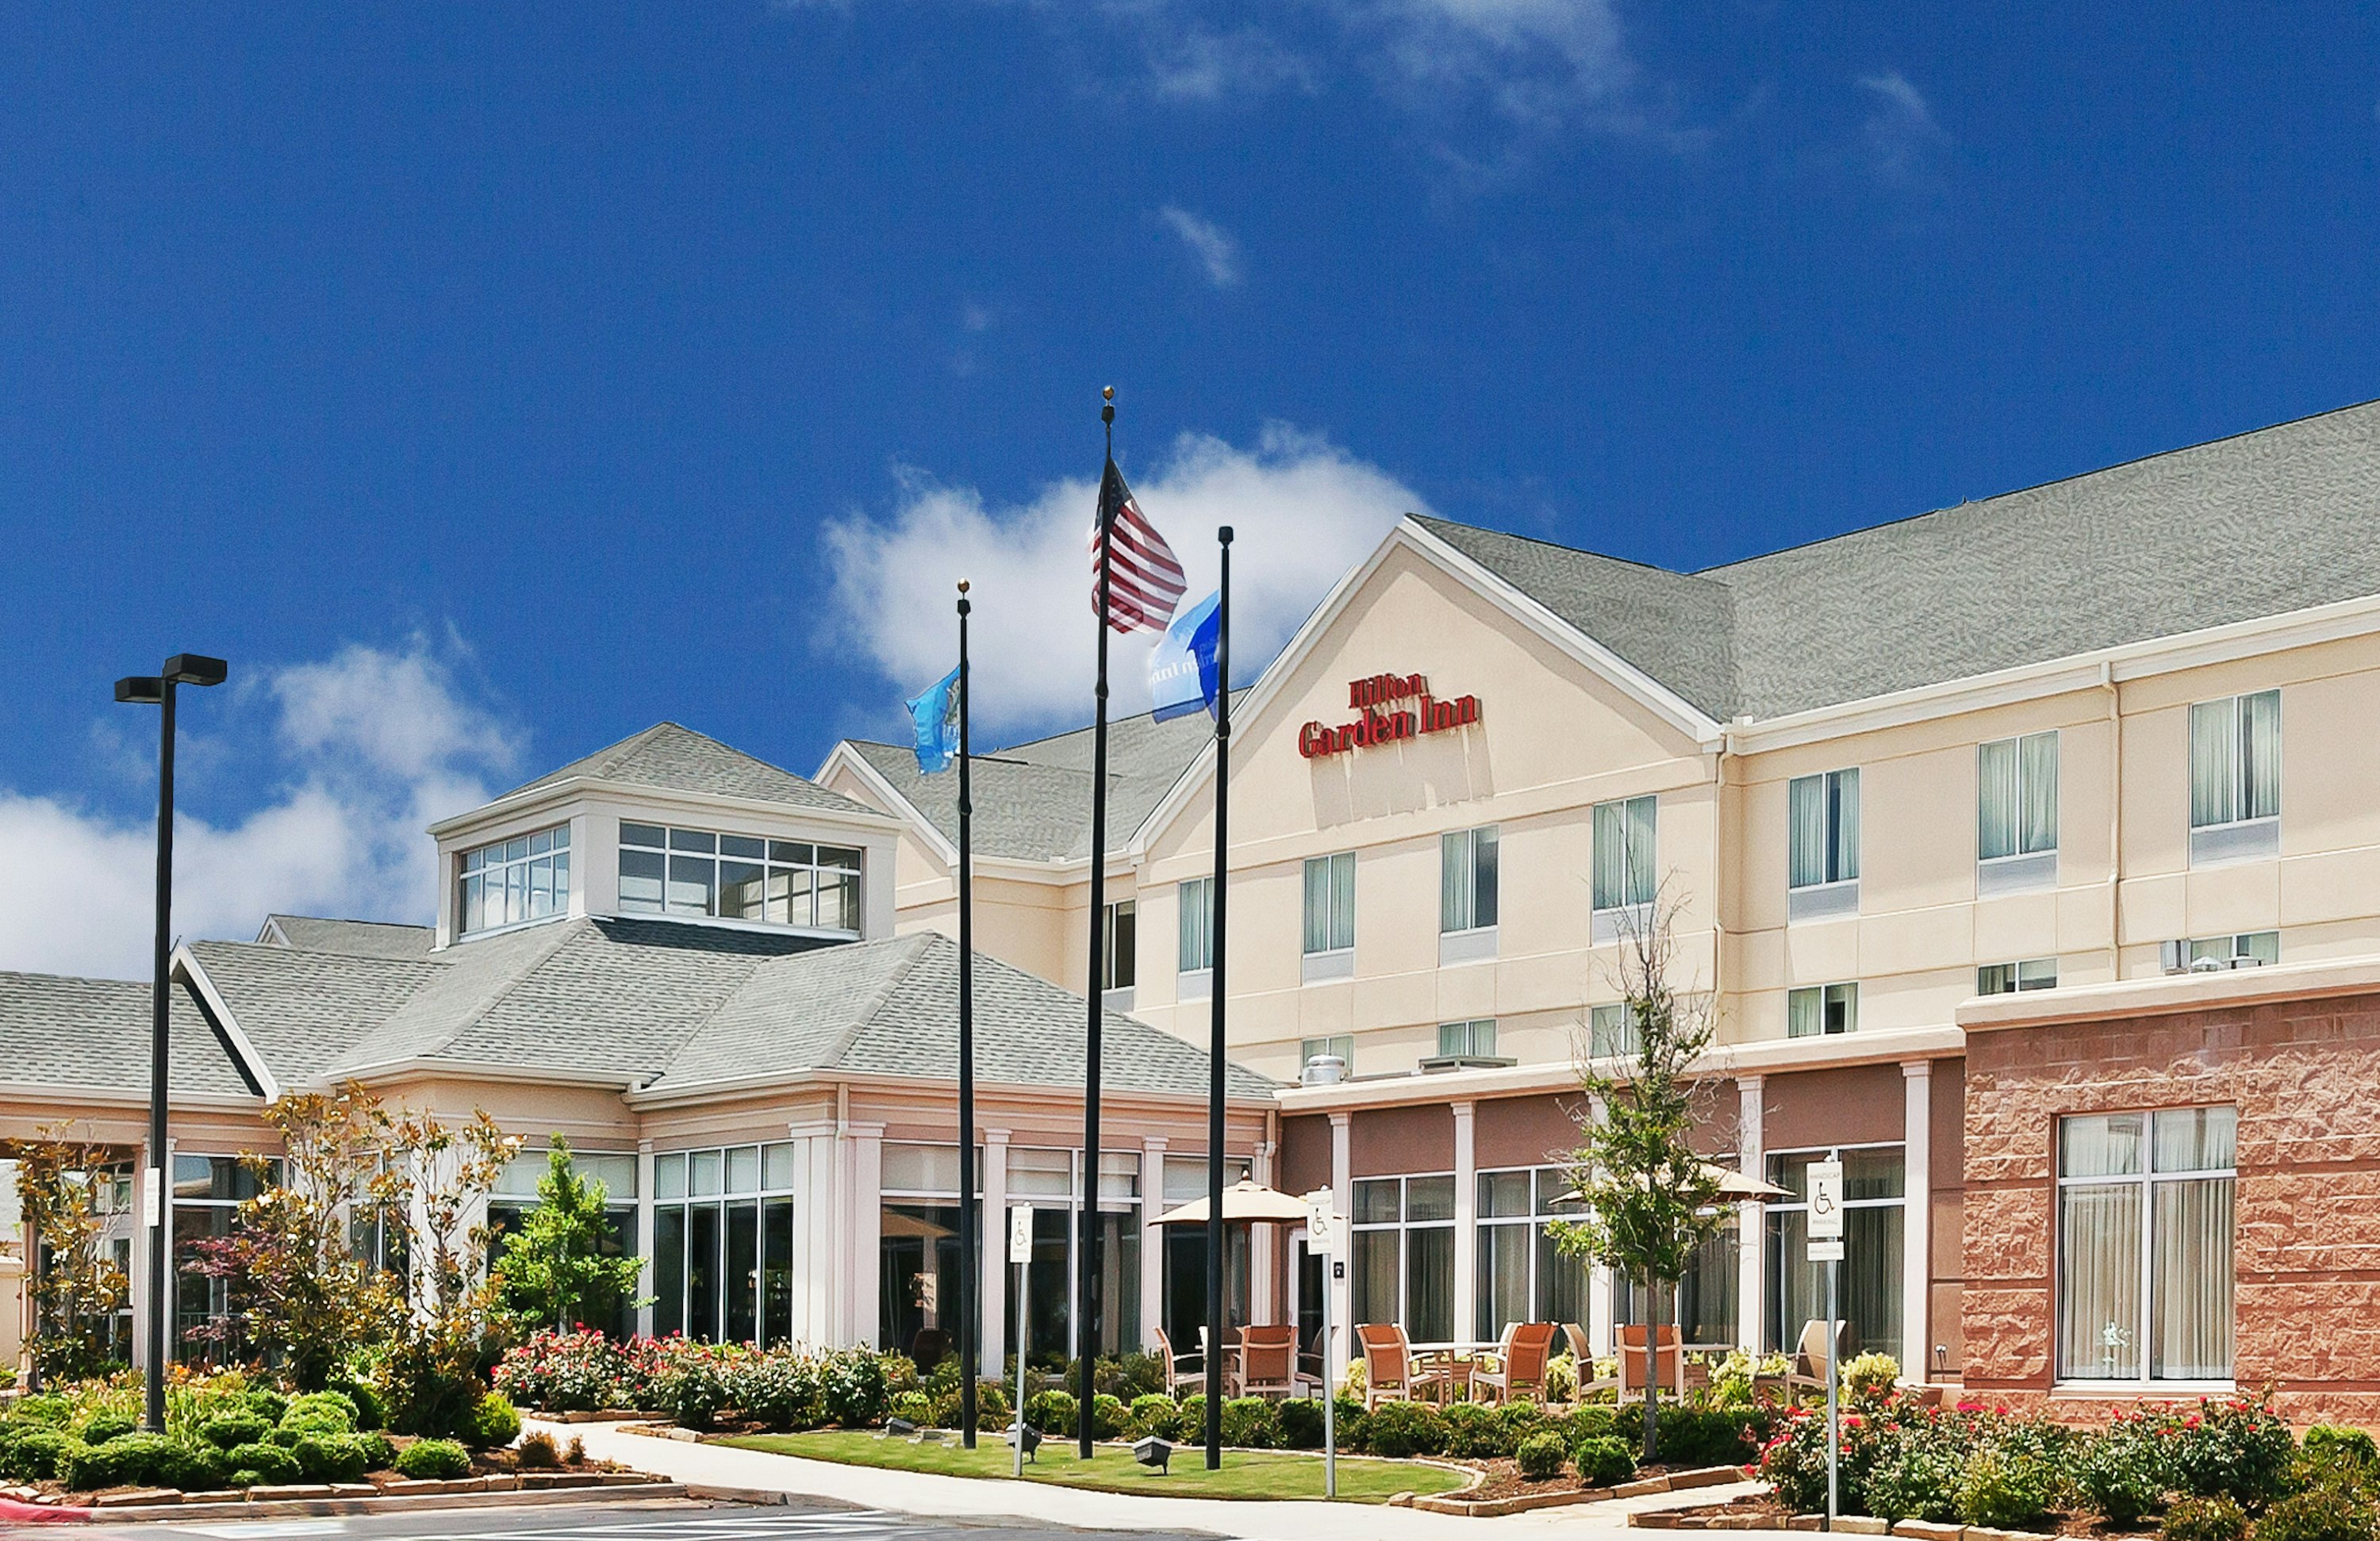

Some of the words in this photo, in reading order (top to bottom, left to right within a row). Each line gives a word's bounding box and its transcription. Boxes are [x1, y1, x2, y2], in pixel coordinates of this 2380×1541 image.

[1349, 673, 1424, 708] Hilton
[1299, 706, 1412, 758] Garden
[1418, 695, 1478, 734] Inn
